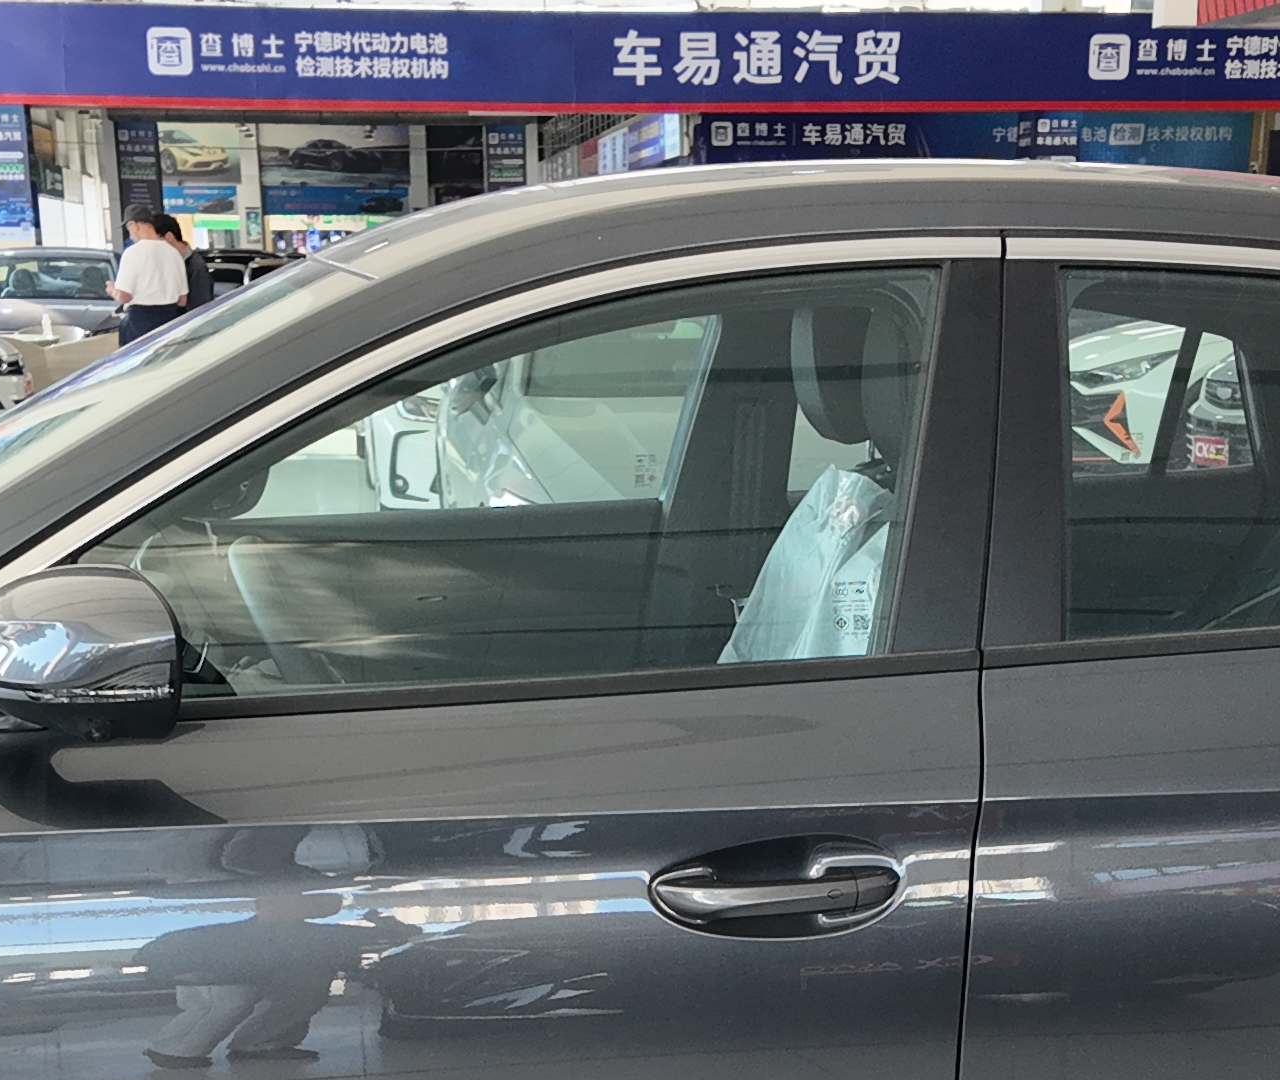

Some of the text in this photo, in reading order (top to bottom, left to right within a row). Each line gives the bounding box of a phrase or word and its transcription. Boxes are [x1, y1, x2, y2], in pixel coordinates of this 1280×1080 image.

[199, 32, 285, 60] 查博士
[294, 31, 449, 56] 宁德时代动力电池
[612, 28, 902, 87] 车易通汽贸
[1136, 38, 1217, 63] 查博士
[295, 56, 450, 80] 检测技术授权机构
[802, 123, 907, 146] 车易通汽贸
[1081, 127, 1107, 143] 电池
[1146, 126, 1233, 143] 技术授权机构
